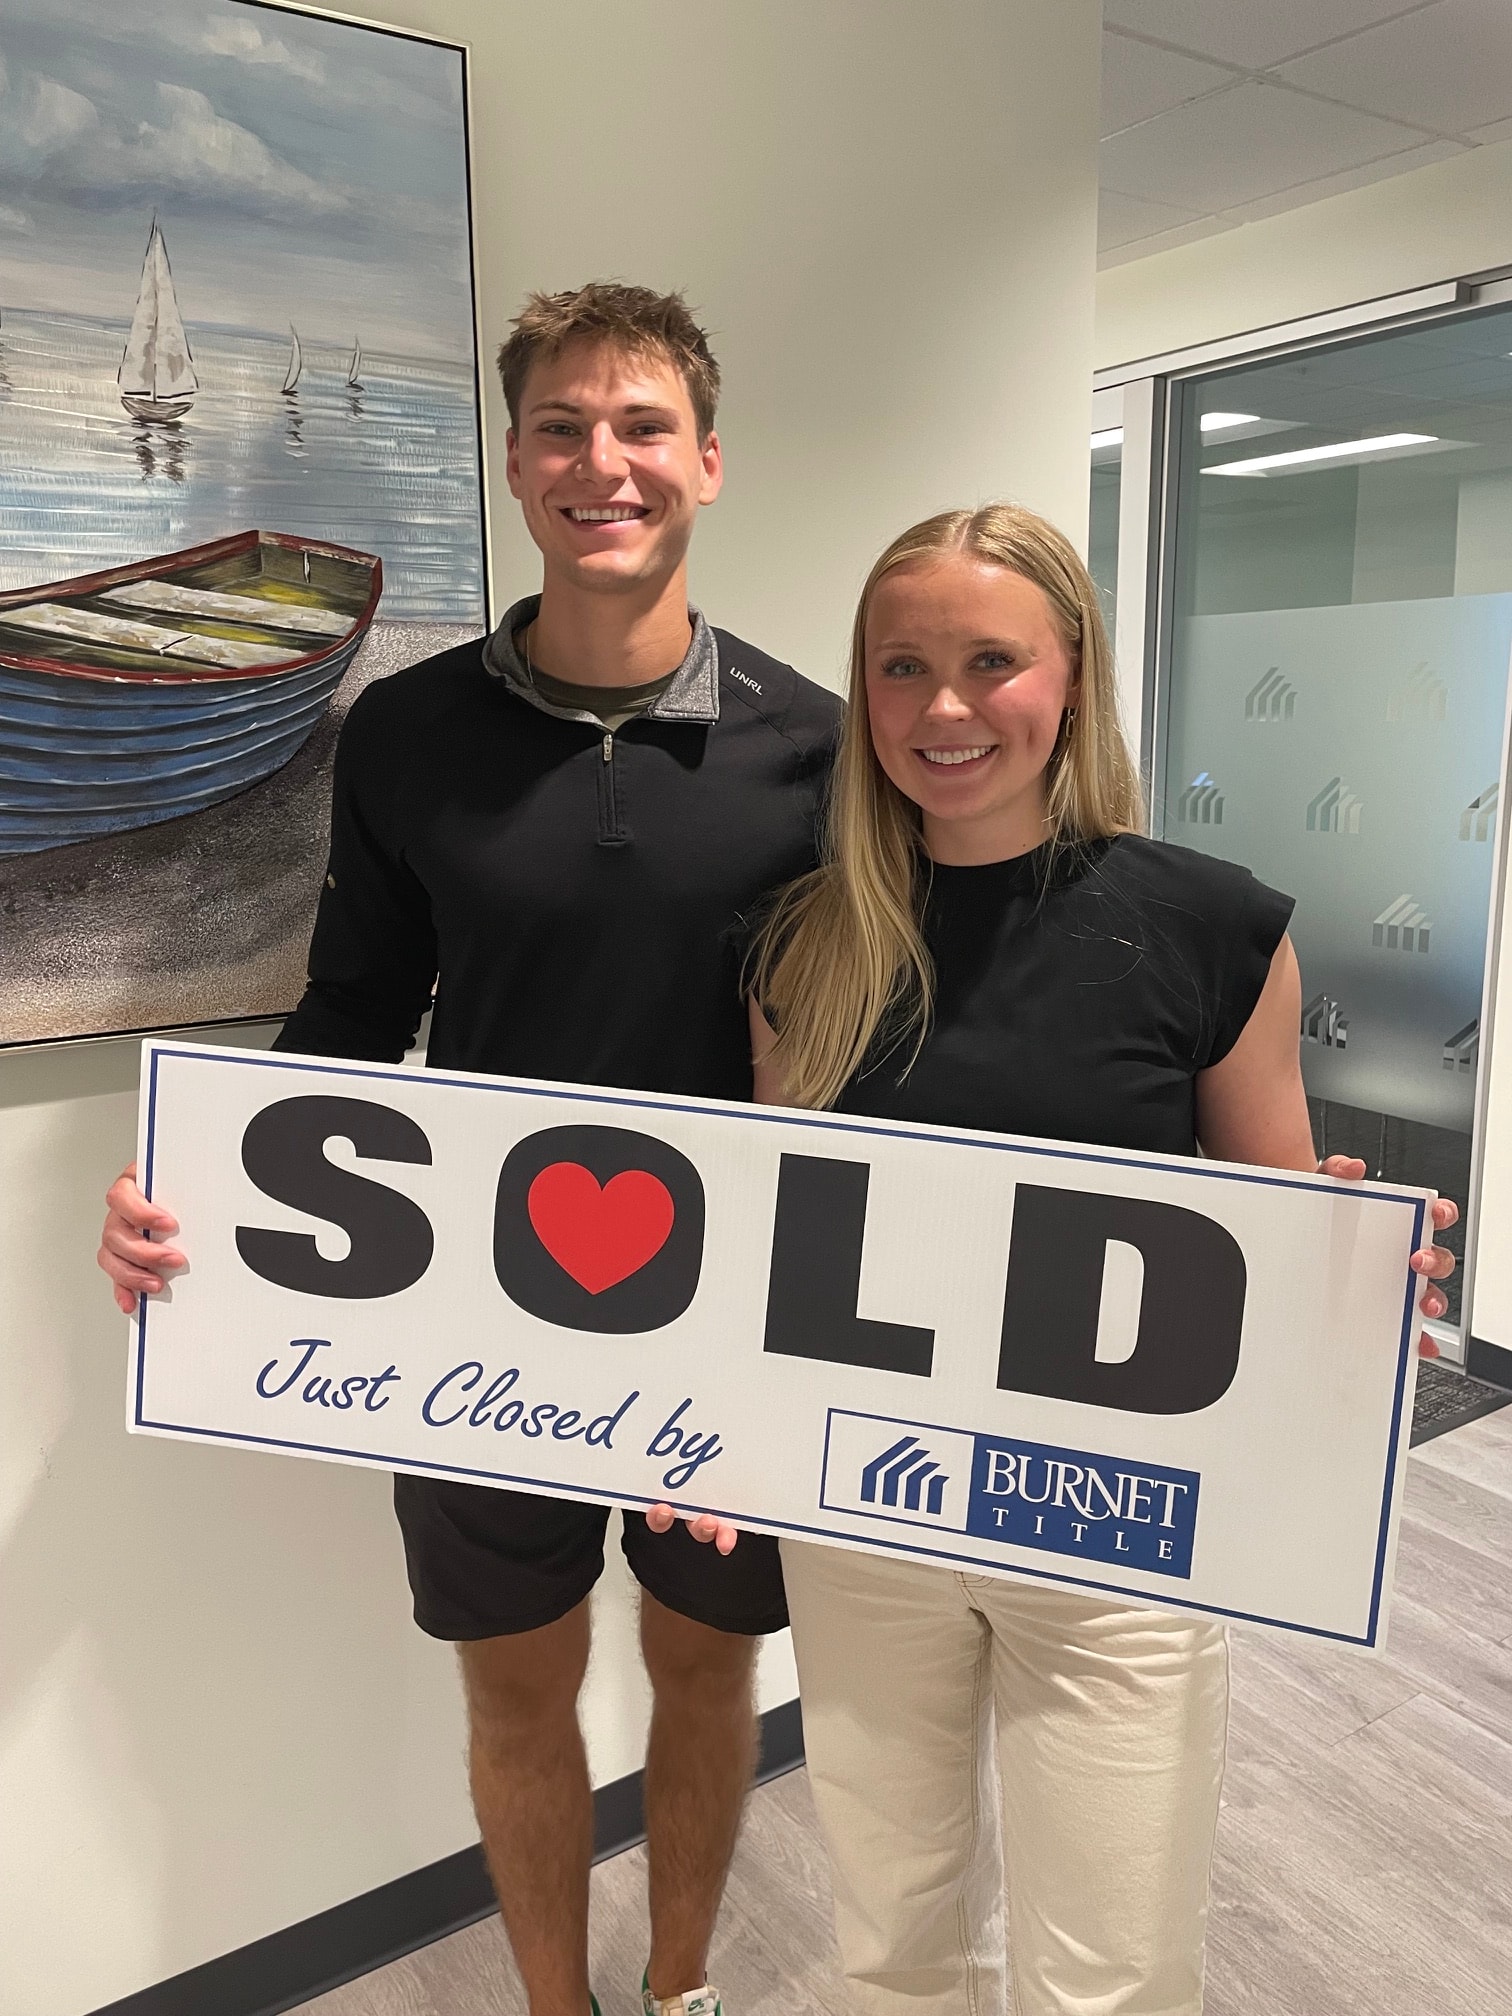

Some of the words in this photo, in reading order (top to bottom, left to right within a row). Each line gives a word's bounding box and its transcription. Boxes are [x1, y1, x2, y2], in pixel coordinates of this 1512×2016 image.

[729, 666, 763, 696] UNRL
[235, 1095, 1247, 1414] SOLD
[256, 1339, 401, 1412] Just
[421, 1361, 639, 1450] Closed
[646, 1398, 723, 1489] by
[982, 1449, 1188, 1528] BURNET
[992, 1507, 1174, 1560] TITLE
